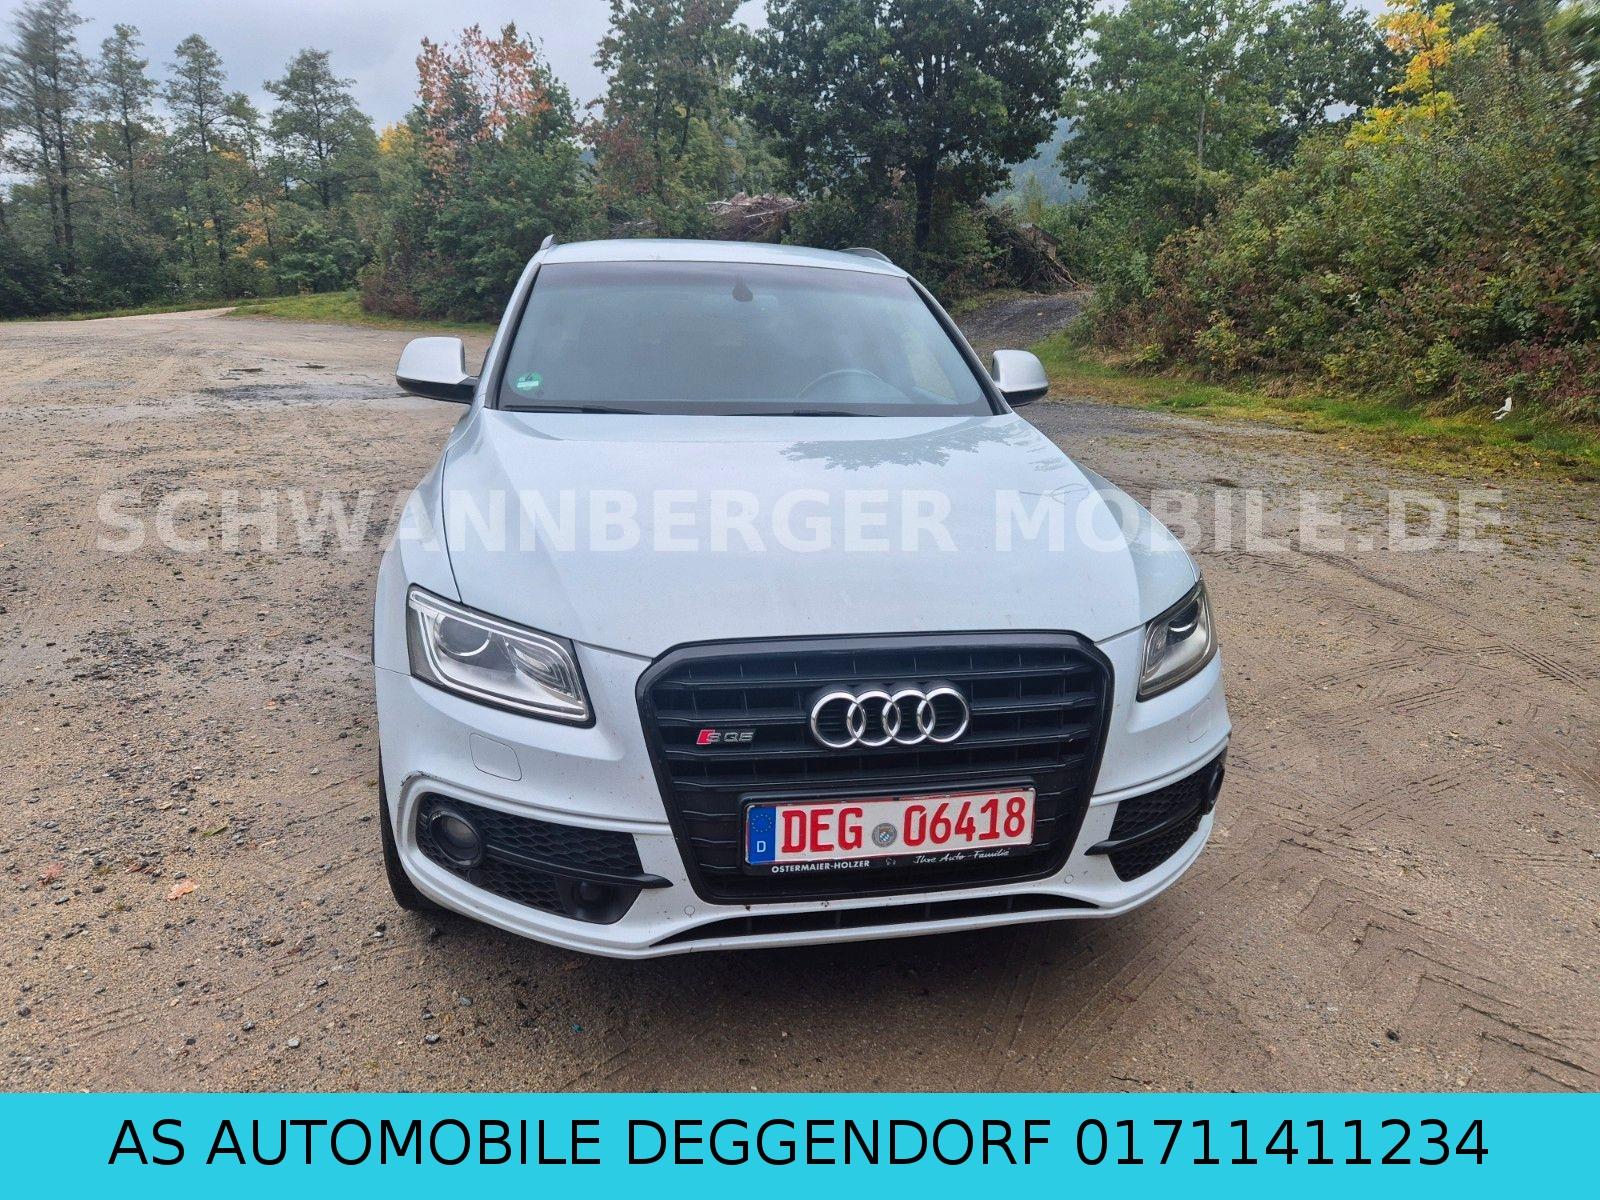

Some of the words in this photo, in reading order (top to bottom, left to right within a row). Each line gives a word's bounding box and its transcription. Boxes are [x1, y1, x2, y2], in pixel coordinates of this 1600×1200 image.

[781, 807, 863, 853] DEG
[902, 796, 1026, 847] 06418
[756, 840, 767, 853] D
[913, 855, 937, 864] Ihre
[771, 860, 870, 873] OSTERMAIER-HOLZER
